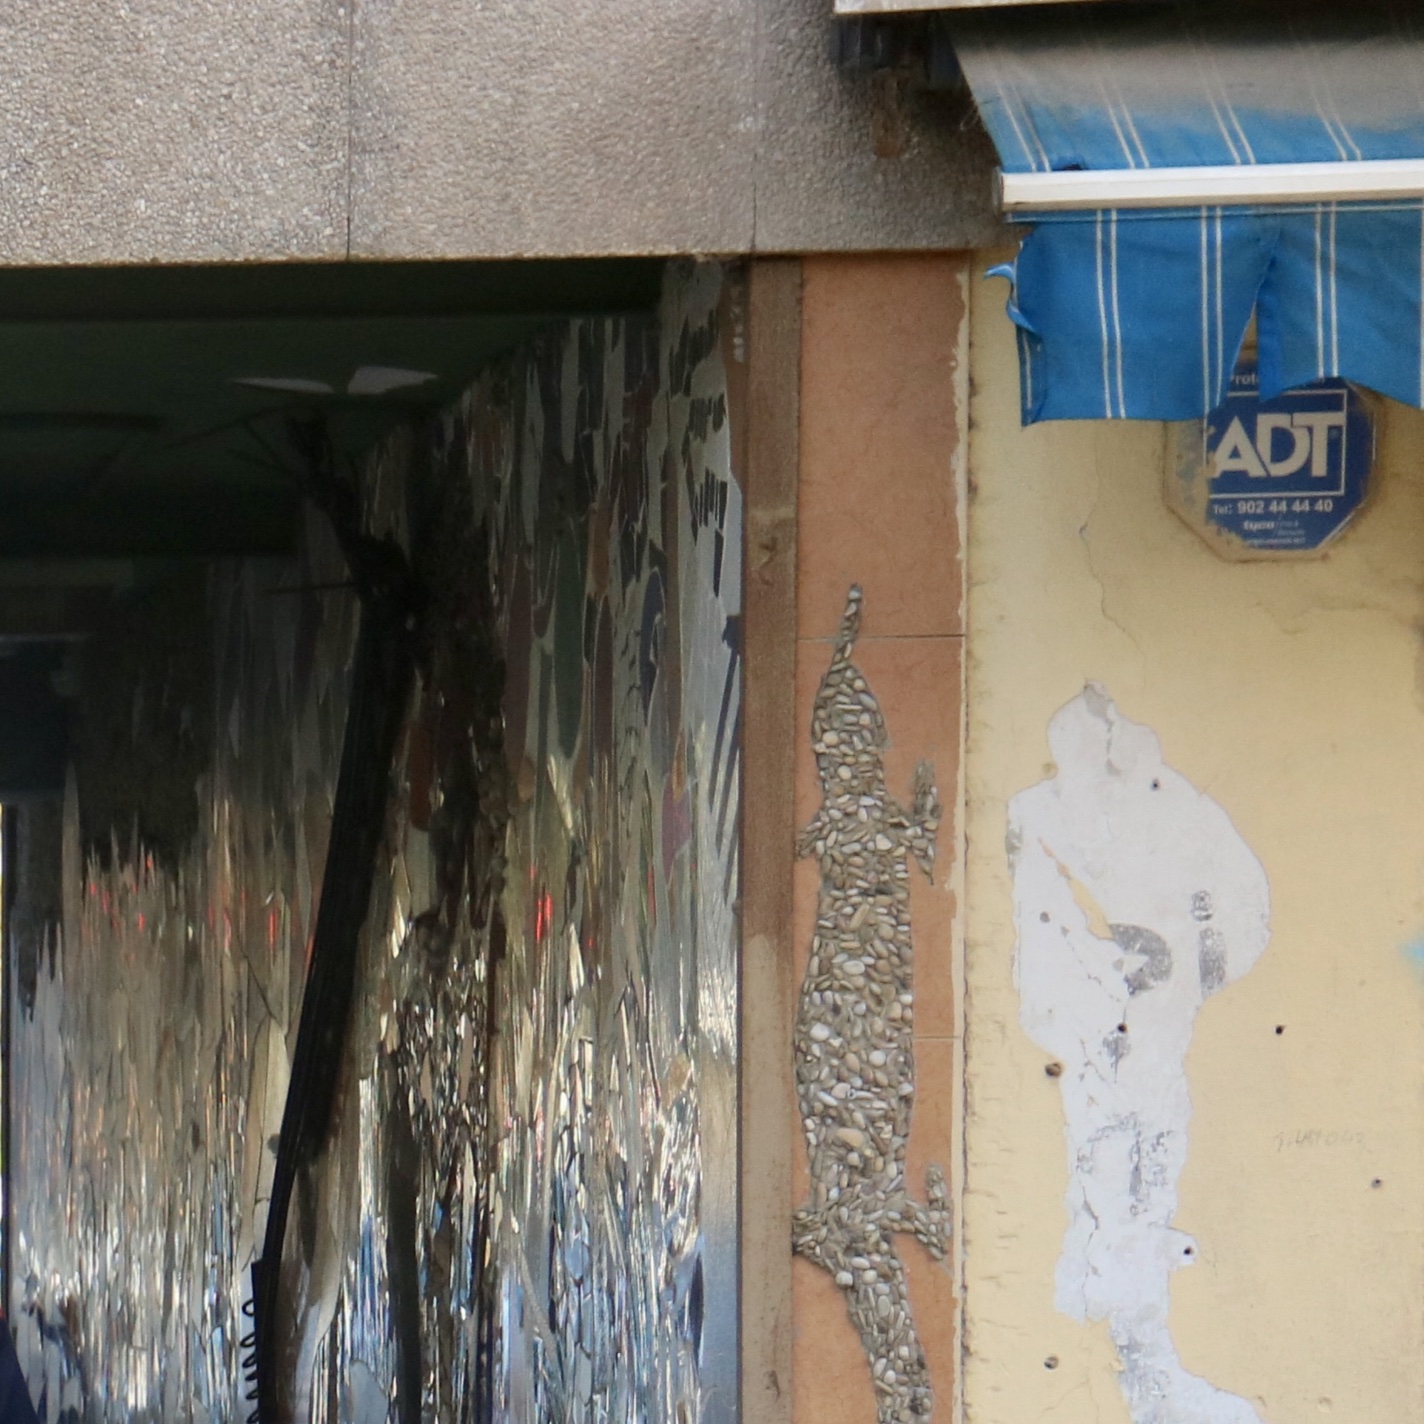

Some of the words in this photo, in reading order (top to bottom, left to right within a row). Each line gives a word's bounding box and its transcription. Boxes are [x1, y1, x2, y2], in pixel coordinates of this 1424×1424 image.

[1209, 412, 1345, 477] ADT
[1237, 501, 1264, 514] 902
[1269, 500, 1287, 514] 44
[1292, 499, 1310, 512] 44
[1314, 499, 1333, 512] 40
